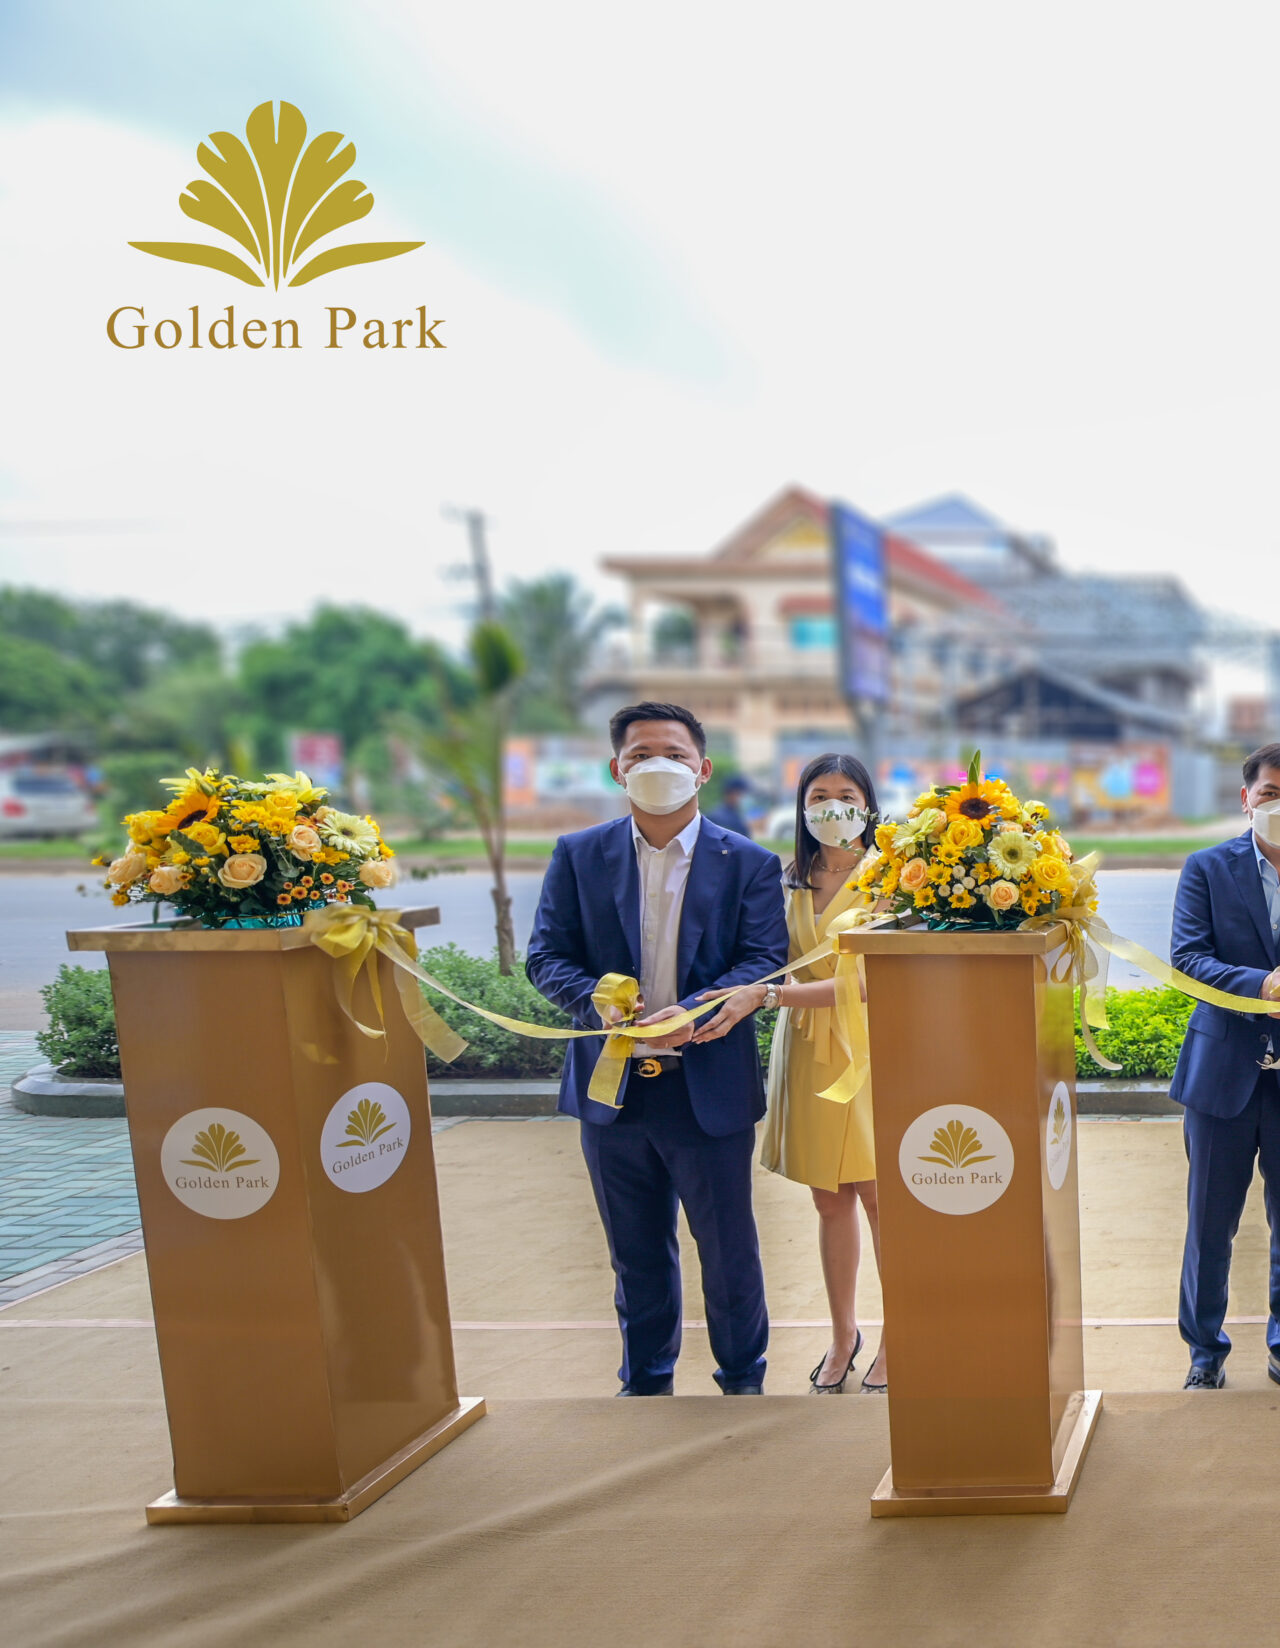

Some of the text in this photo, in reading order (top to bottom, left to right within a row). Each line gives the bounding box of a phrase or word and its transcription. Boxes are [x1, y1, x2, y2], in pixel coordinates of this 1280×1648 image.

[332, 1136, 405, 1175] Golden Park
[175, 1176, 270, 1189] Golden Park
[911, 1171, 1003, 1185] Golden Park
